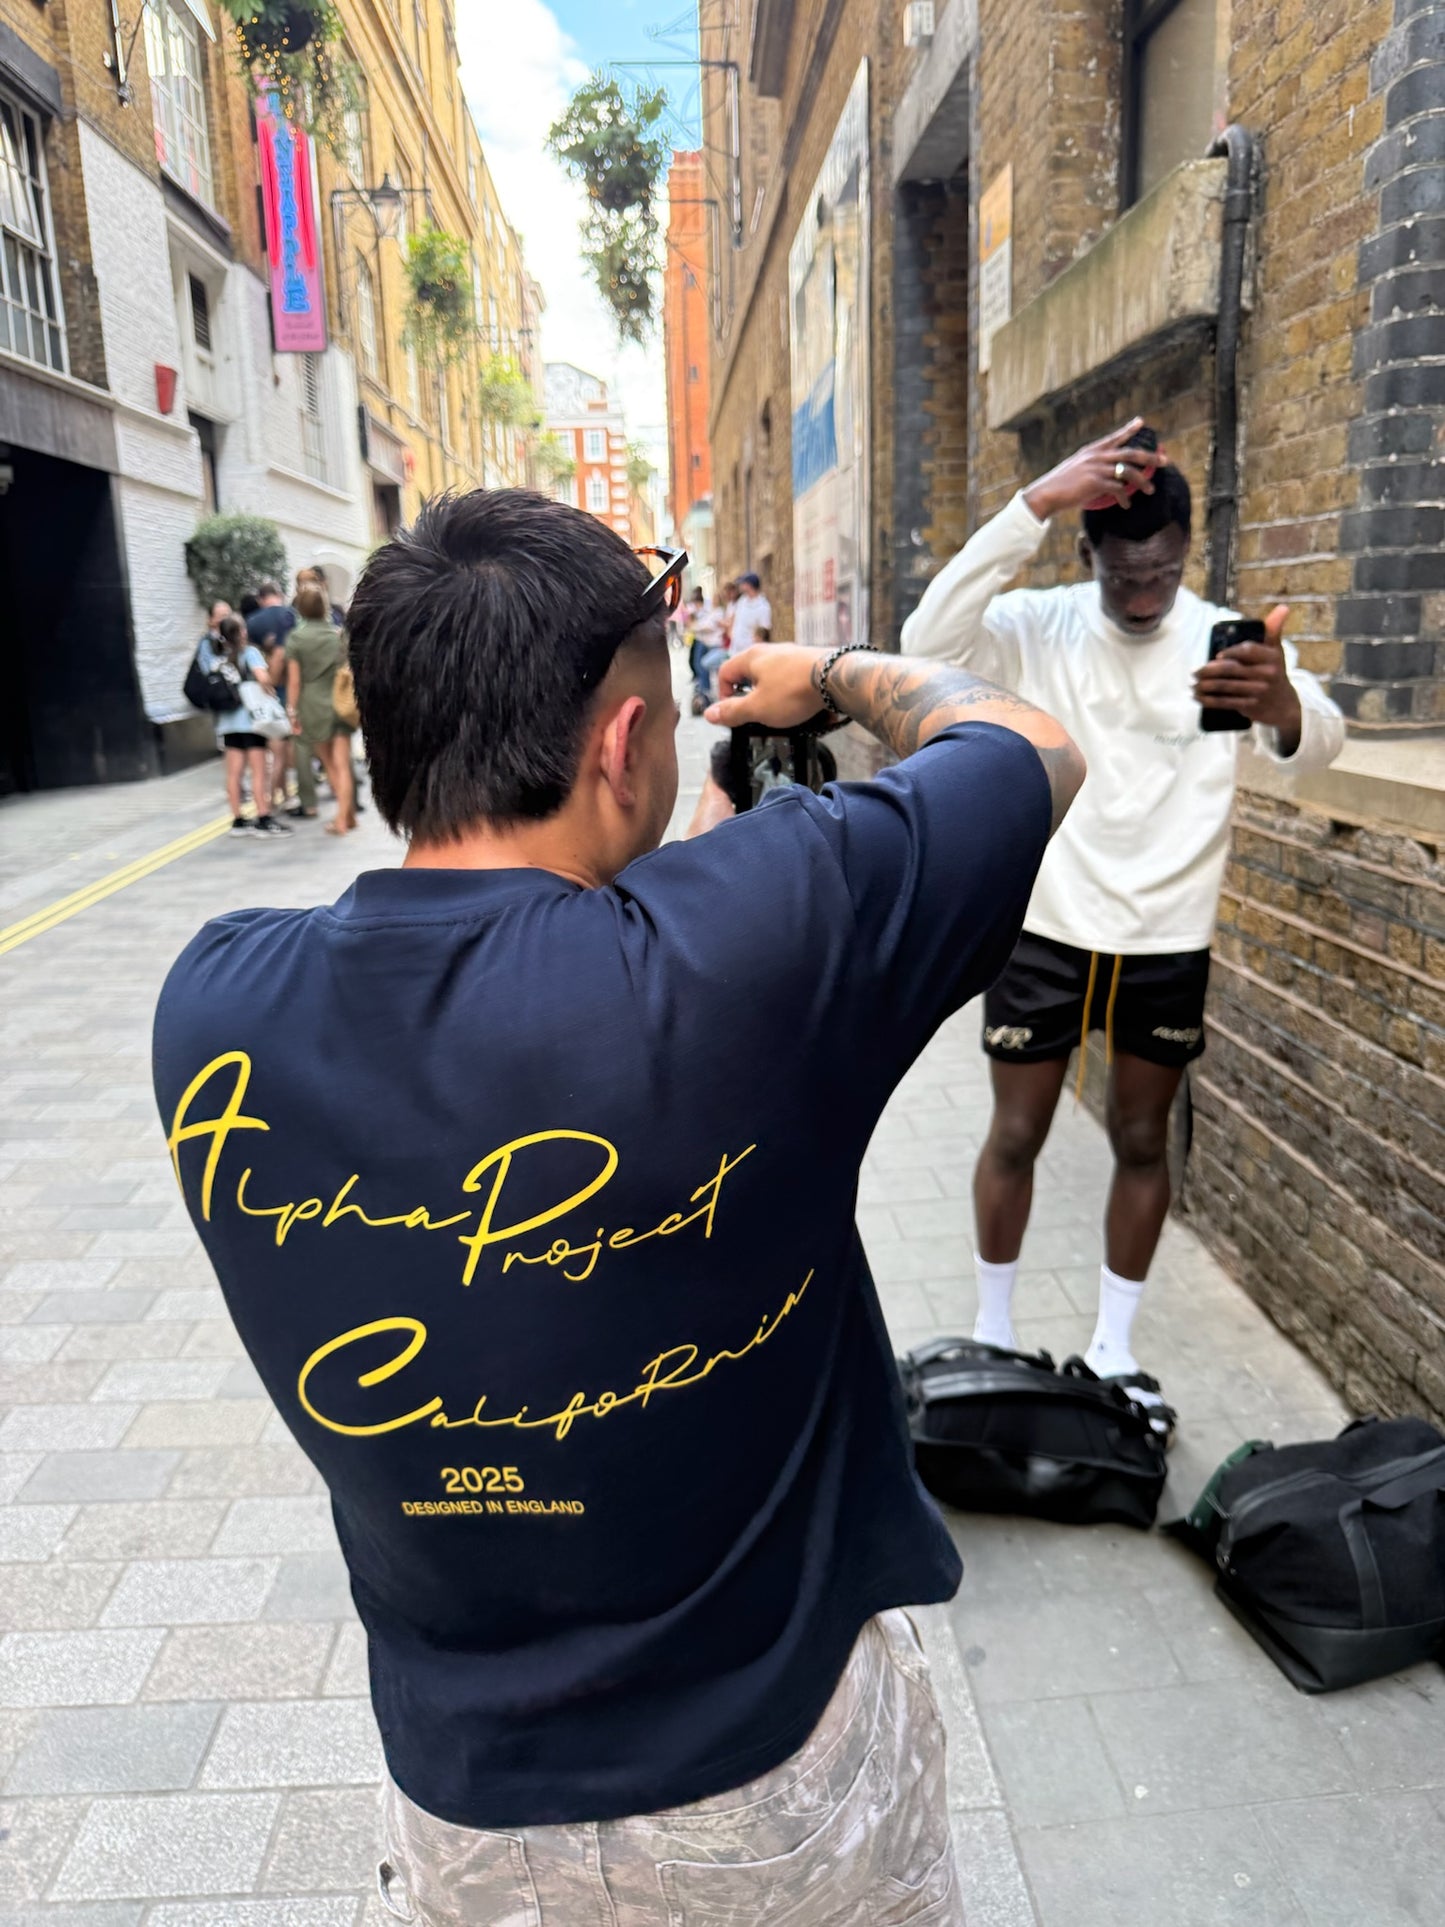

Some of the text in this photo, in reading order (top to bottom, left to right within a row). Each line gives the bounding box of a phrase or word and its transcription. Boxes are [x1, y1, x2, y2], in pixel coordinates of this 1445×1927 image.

[166, 1050, 756, 1287] Alpha Project
[440, 1466, 525, 1493] 2025
[402, 1500, 585, 1516] DESIGNED IN ENGLAND
